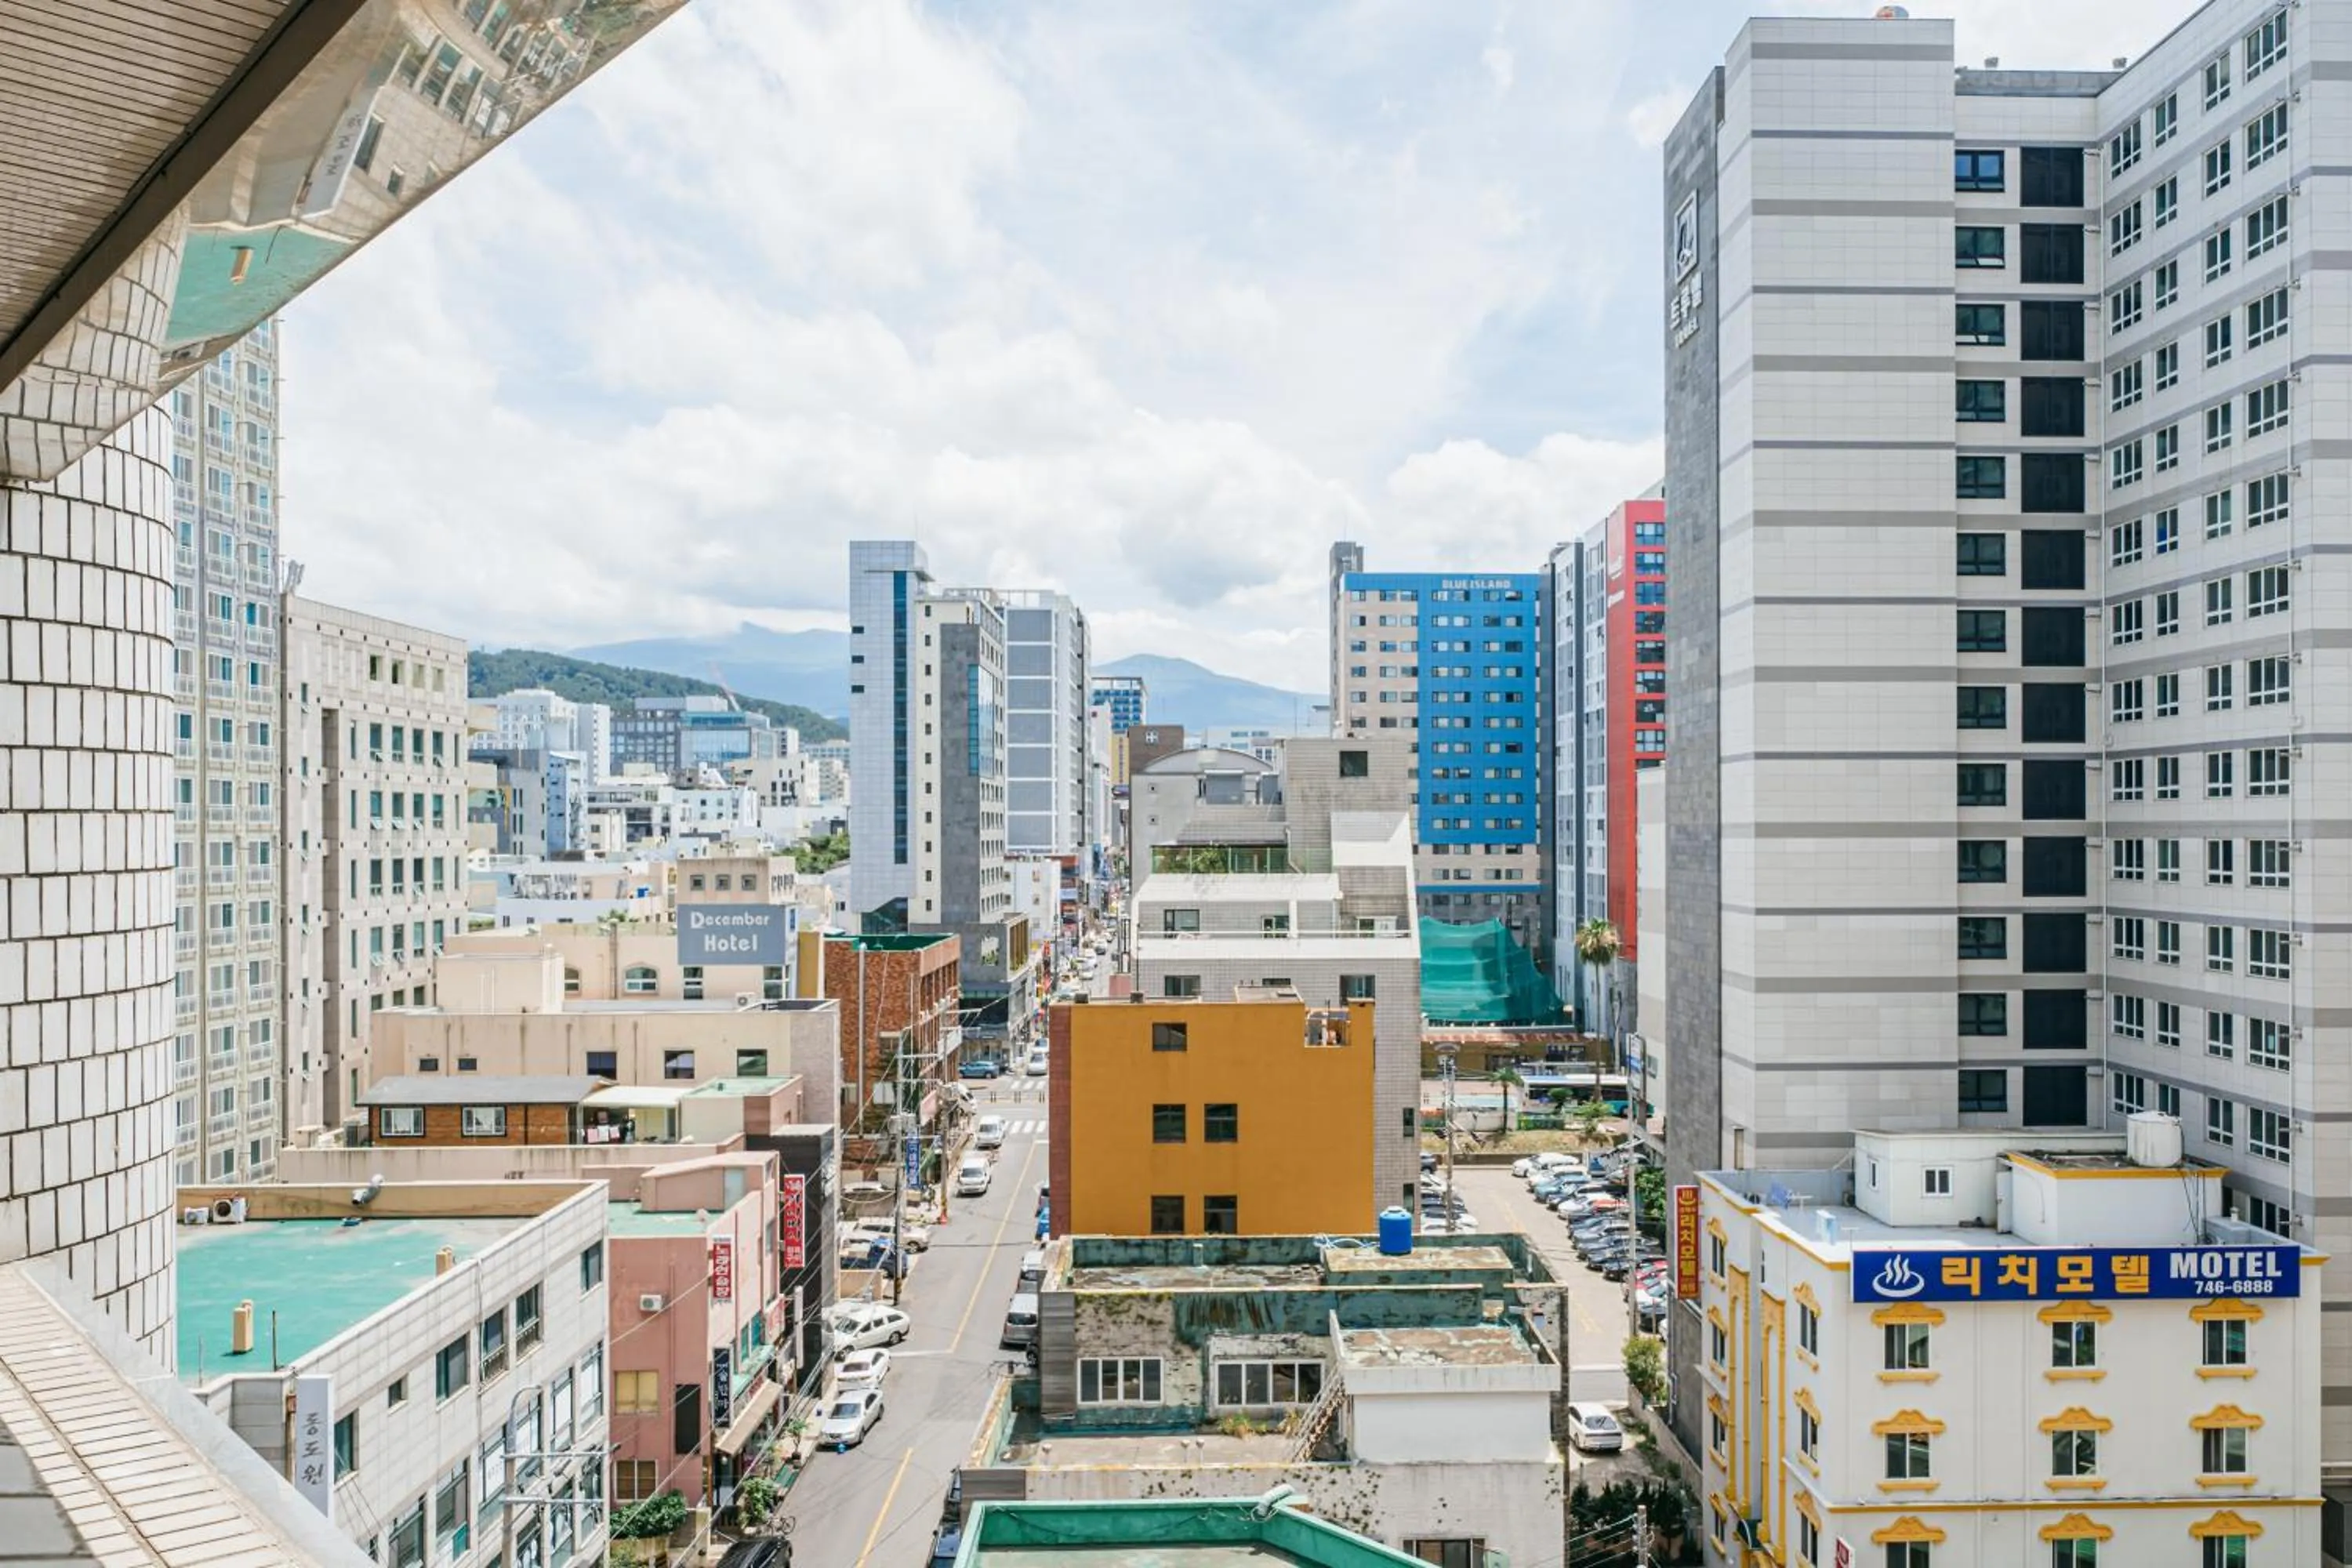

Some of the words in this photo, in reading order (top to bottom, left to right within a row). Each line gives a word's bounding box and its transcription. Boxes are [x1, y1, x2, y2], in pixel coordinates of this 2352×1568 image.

[1442, 579, 1468, 589] BLUE
[1471, 579, 1511, 589] ISLAND
[690, 911, 770, 928] December
[704, 934, 758, 952] Hotel
[1680, 1214, 1697, 1276] 리치모텔
[1941, 1255, 2150, 1295] 리치모텔
[2170, 1252, 2282, 1279] MOTEL
[2194, 1279, 2273, 1294] 746-6888
[301, 1412, 325, 1486] 동도원
